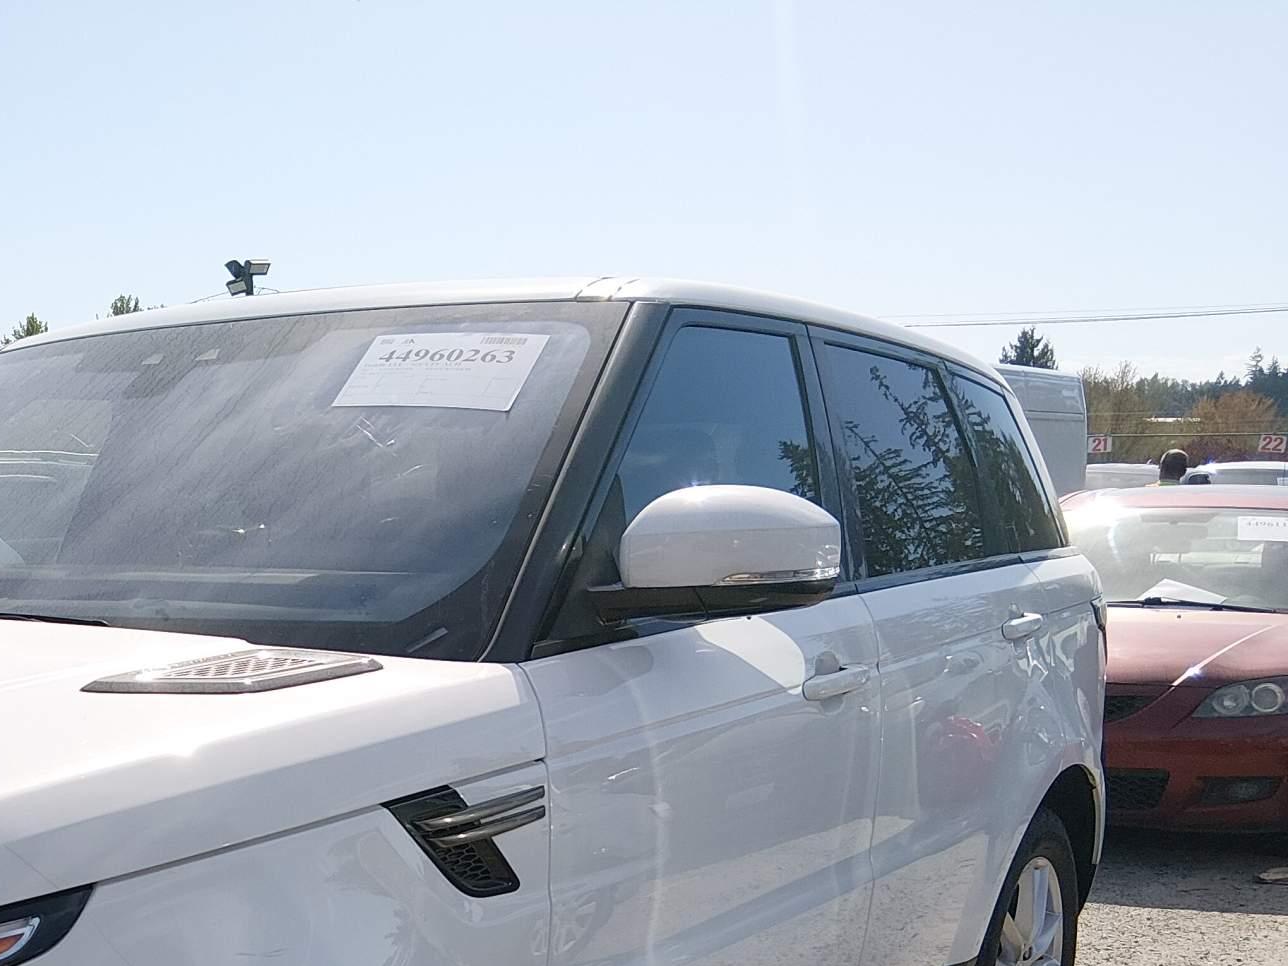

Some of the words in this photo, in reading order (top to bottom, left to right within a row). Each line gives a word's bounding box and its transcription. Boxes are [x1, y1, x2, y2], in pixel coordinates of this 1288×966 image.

[379, 349, 516, 364] 44960263
[1091, 437, 1108, 452] 21
[1262, 436, 1284, 452] 22
